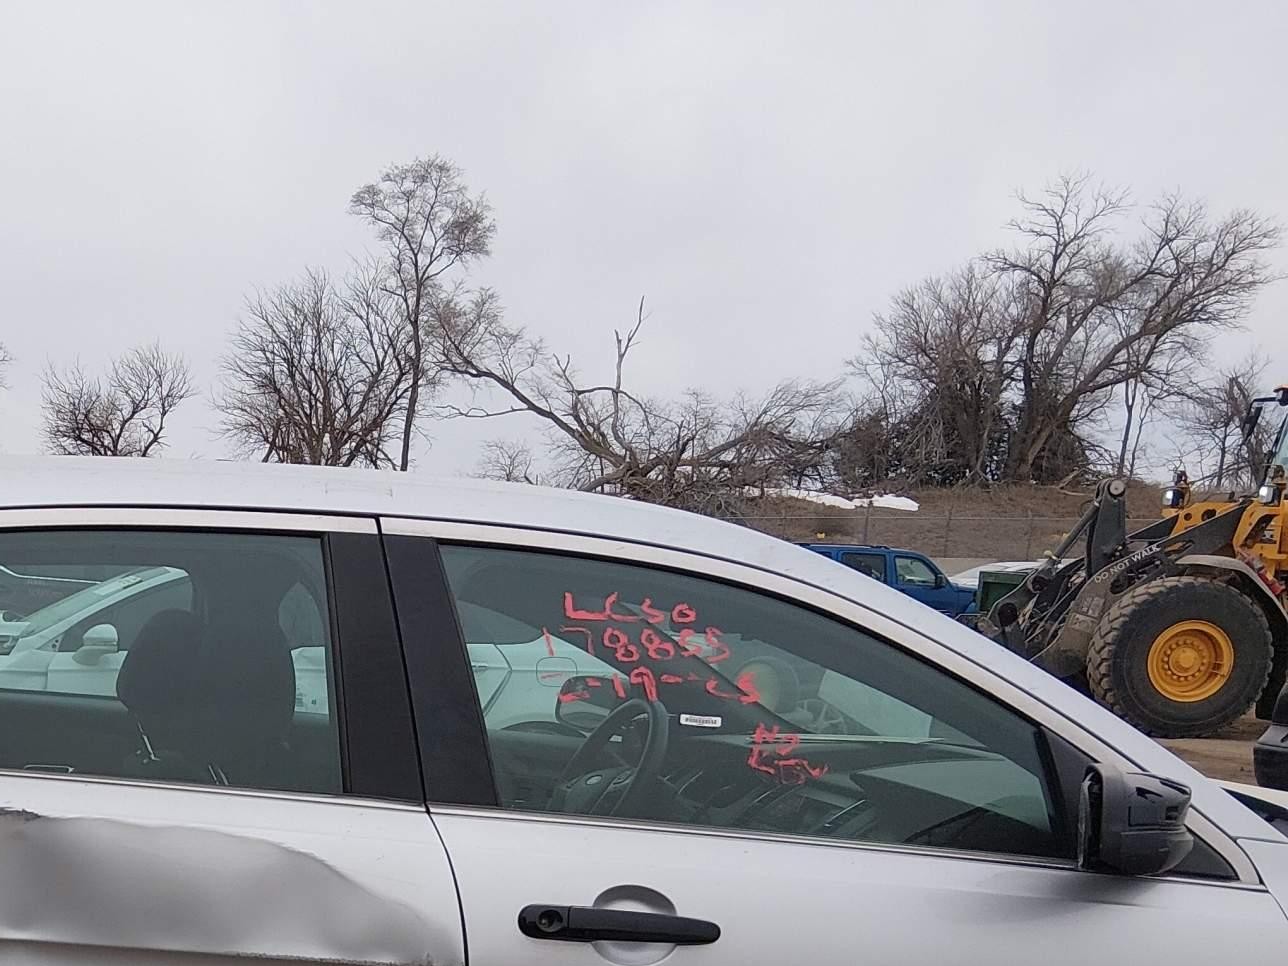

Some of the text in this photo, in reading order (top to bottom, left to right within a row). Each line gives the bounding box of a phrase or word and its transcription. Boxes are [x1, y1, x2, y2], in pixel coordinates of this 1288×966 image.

[1094, 544, 1162, 584] DO NOT WALK
